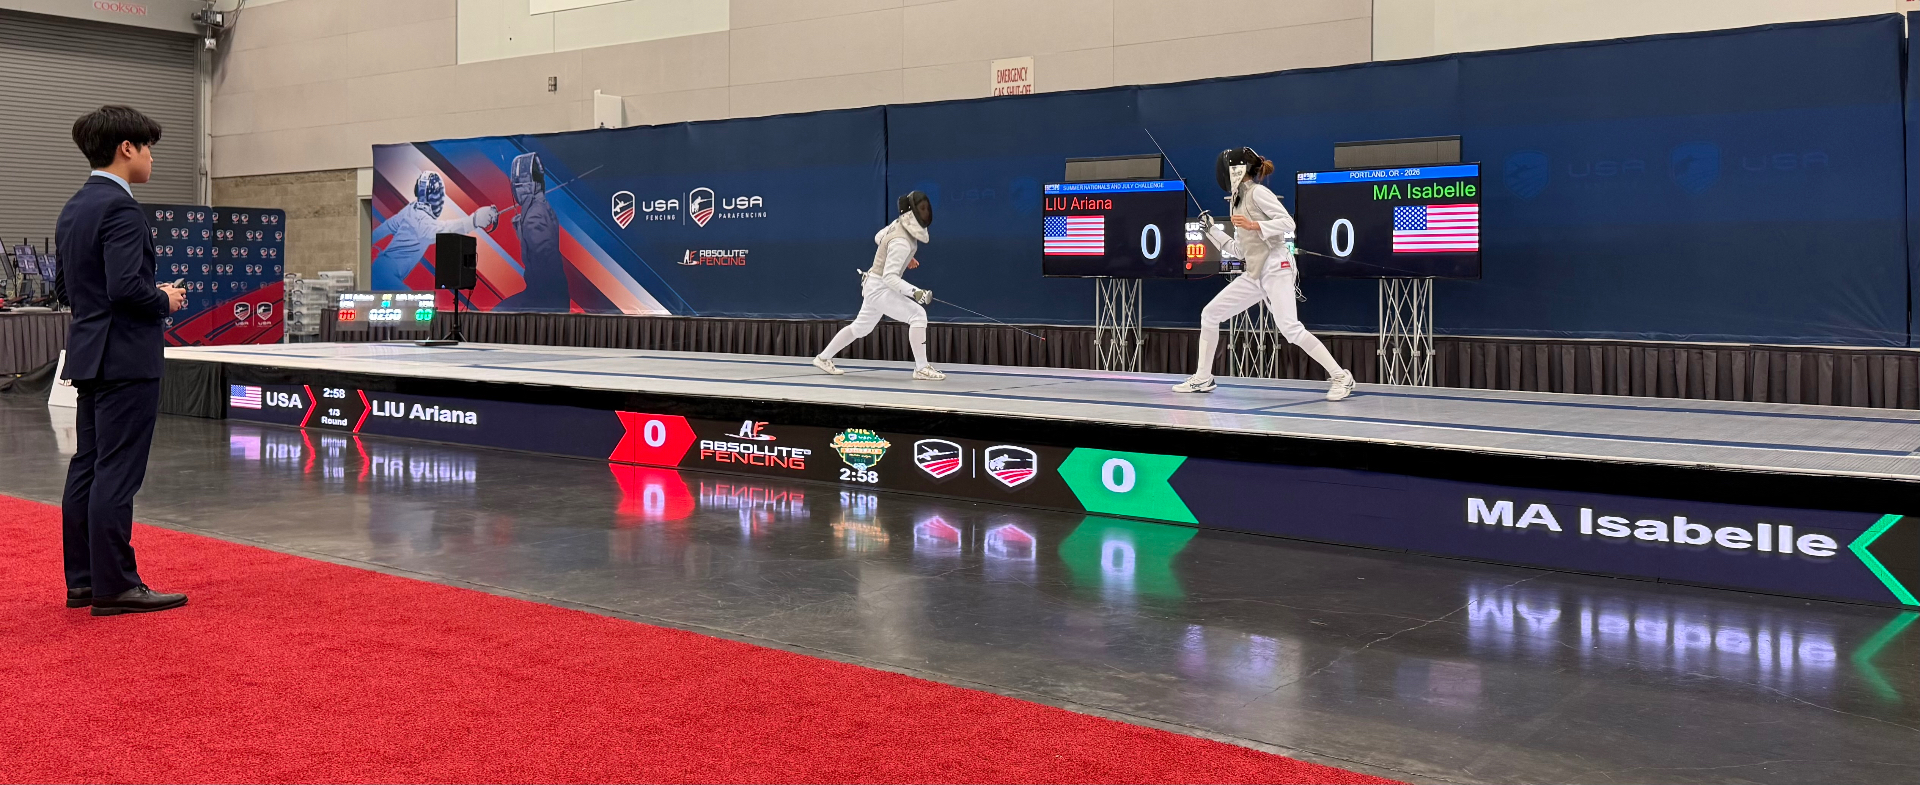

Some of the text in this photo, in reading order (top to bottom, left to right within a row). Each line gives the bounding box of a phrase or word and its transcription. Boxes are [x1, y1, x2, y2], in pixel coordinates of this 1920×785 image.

[93, 1, 147, 15] COOKSON
[996, 66, 1028, 84] EMERGENCY
[1350, 170, 1388, 178] PORTLAND,
[1404, 168, 1420, 176] 2026
[1373, 181, 1476, 200] MA Isabelle
[642, 199, 679, 212] USA
[722, 196, 763, 210] USA
[1046, 196, 1112, 210] LIU Ariana
[1141, 224, 1160, 260] 0
[1330, 218, 1354, 257] 0
[700, 257, 746, 266] FENCING
[266, 391, 302, 408] USA
[322, 388, 346, 398] 2:58
[328, 408, 340, 416] 1/3
[372, 400, 478, 424] LIU Ariana
[321, 416, 348, 426] Round
[644, 420, 666, 448] 0
[700, 450, 806, 470] FENCING
[840, 468, 879, 484] 2:58
[1101, 458, 1136, 493] 0
[1467, 497, 1838, 557] MA Isabelle
